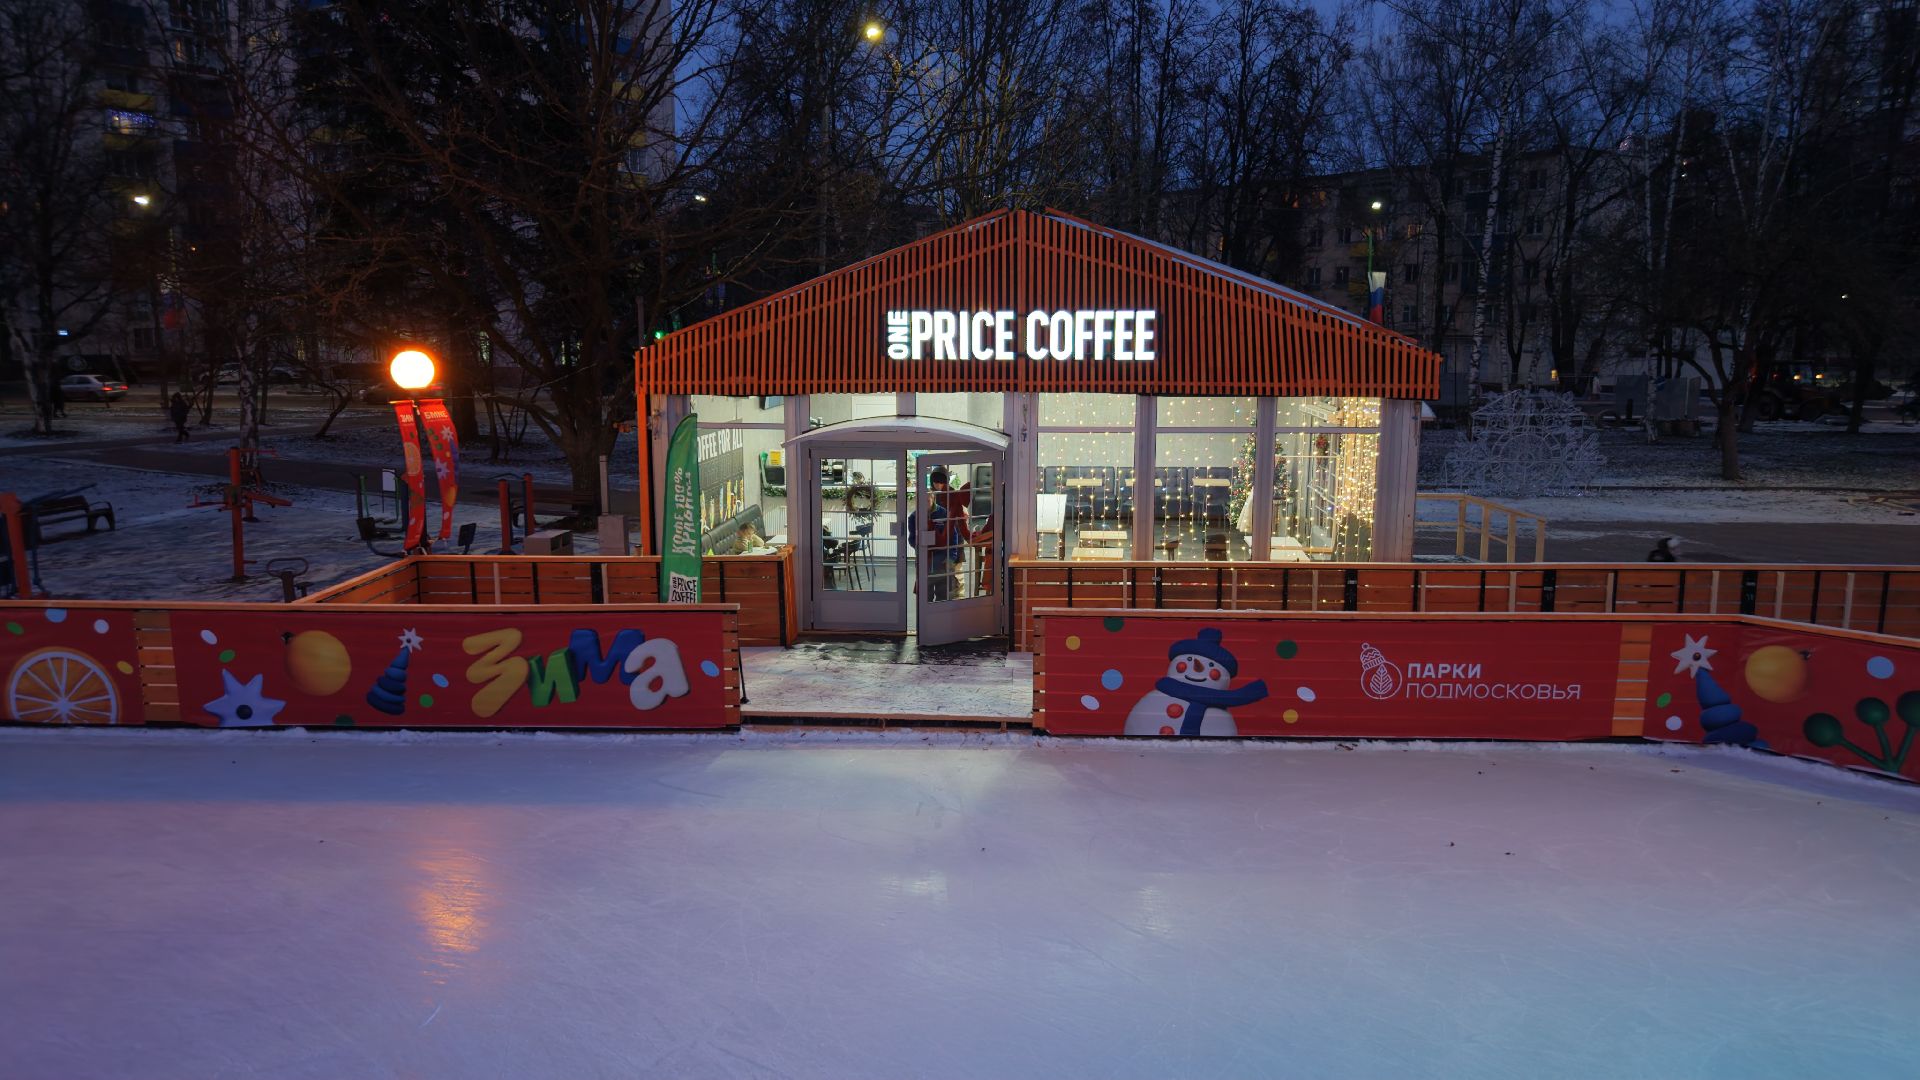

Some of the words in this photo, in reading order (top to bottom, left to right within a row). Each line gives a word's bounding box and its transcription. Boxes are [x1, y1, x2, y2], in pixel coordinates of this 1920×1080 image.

[887, 310, 908, 360] ONE
[911, 310, 1014, 360] PRICE
[1026, 310, 1156, 361] COFFEE
[697, 432, 718, 463] OFFEE
[717, 428, 731, 455] FOR
[732, 428, 743, 451] ALL
[674, 467, 685, 509] 100%
[1407, 663, 1482, 679] ПАРКИ
[1406, 683, 1581, 700] ПОДМОСКОВЬЯ
